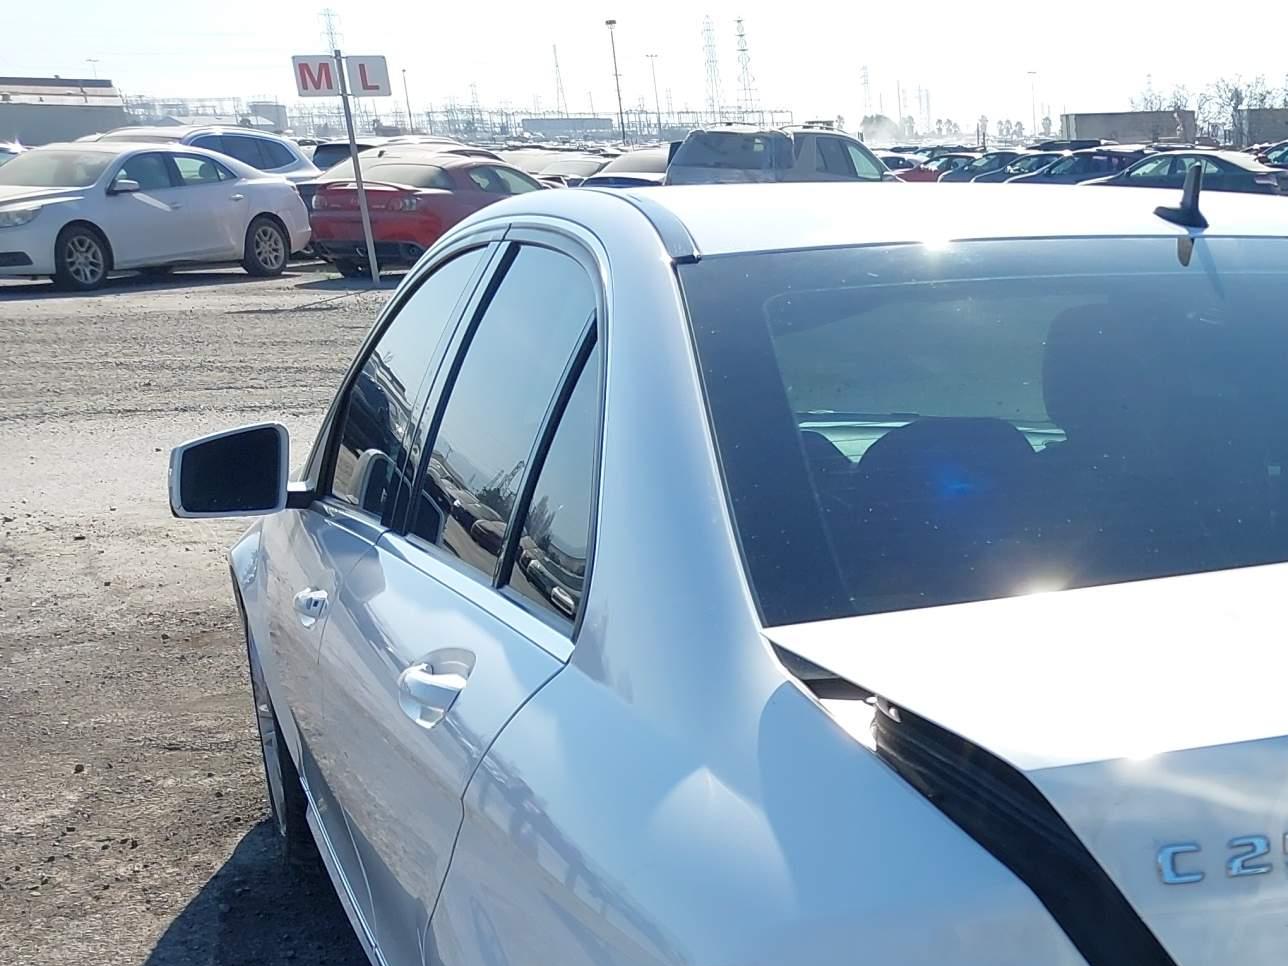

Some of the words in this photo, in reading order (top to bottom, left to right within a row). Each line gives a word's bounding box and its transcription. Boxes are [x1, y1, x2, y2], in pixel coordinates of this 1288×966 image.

[298, 62, 333, 90] M
[358, 63, 380, 90] L
[1157, 842, 1205, 885] C
